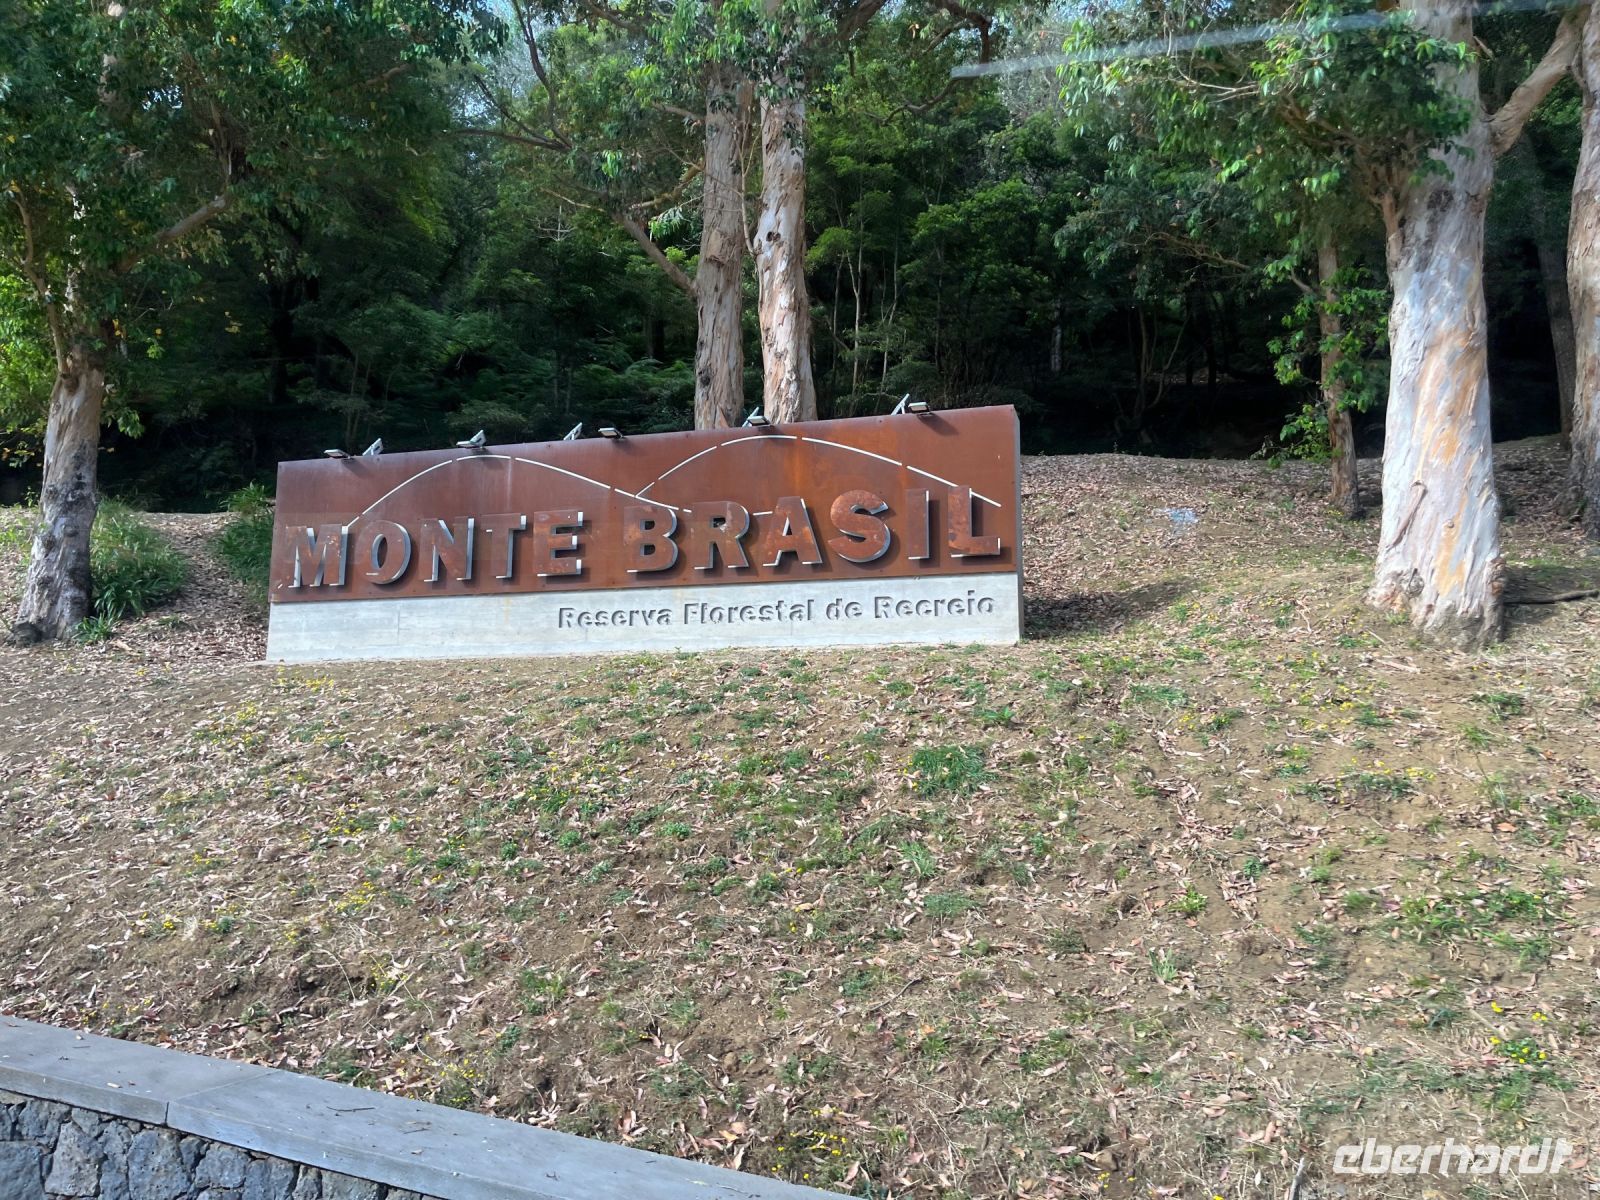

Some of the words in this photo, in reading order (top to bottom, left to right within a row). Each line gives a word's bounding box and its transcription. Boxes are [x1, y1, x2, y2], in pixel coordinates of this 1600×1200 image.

[285, 509, 584, 588] MONTE
[623, 486, 1001, 573] BRASIL
[558, 607, 672, 629] Reserva
[683, 598, 815, 625] Florestal
[825, 597, 863, 621] de
[873, 589, 995, 619] Recreio
